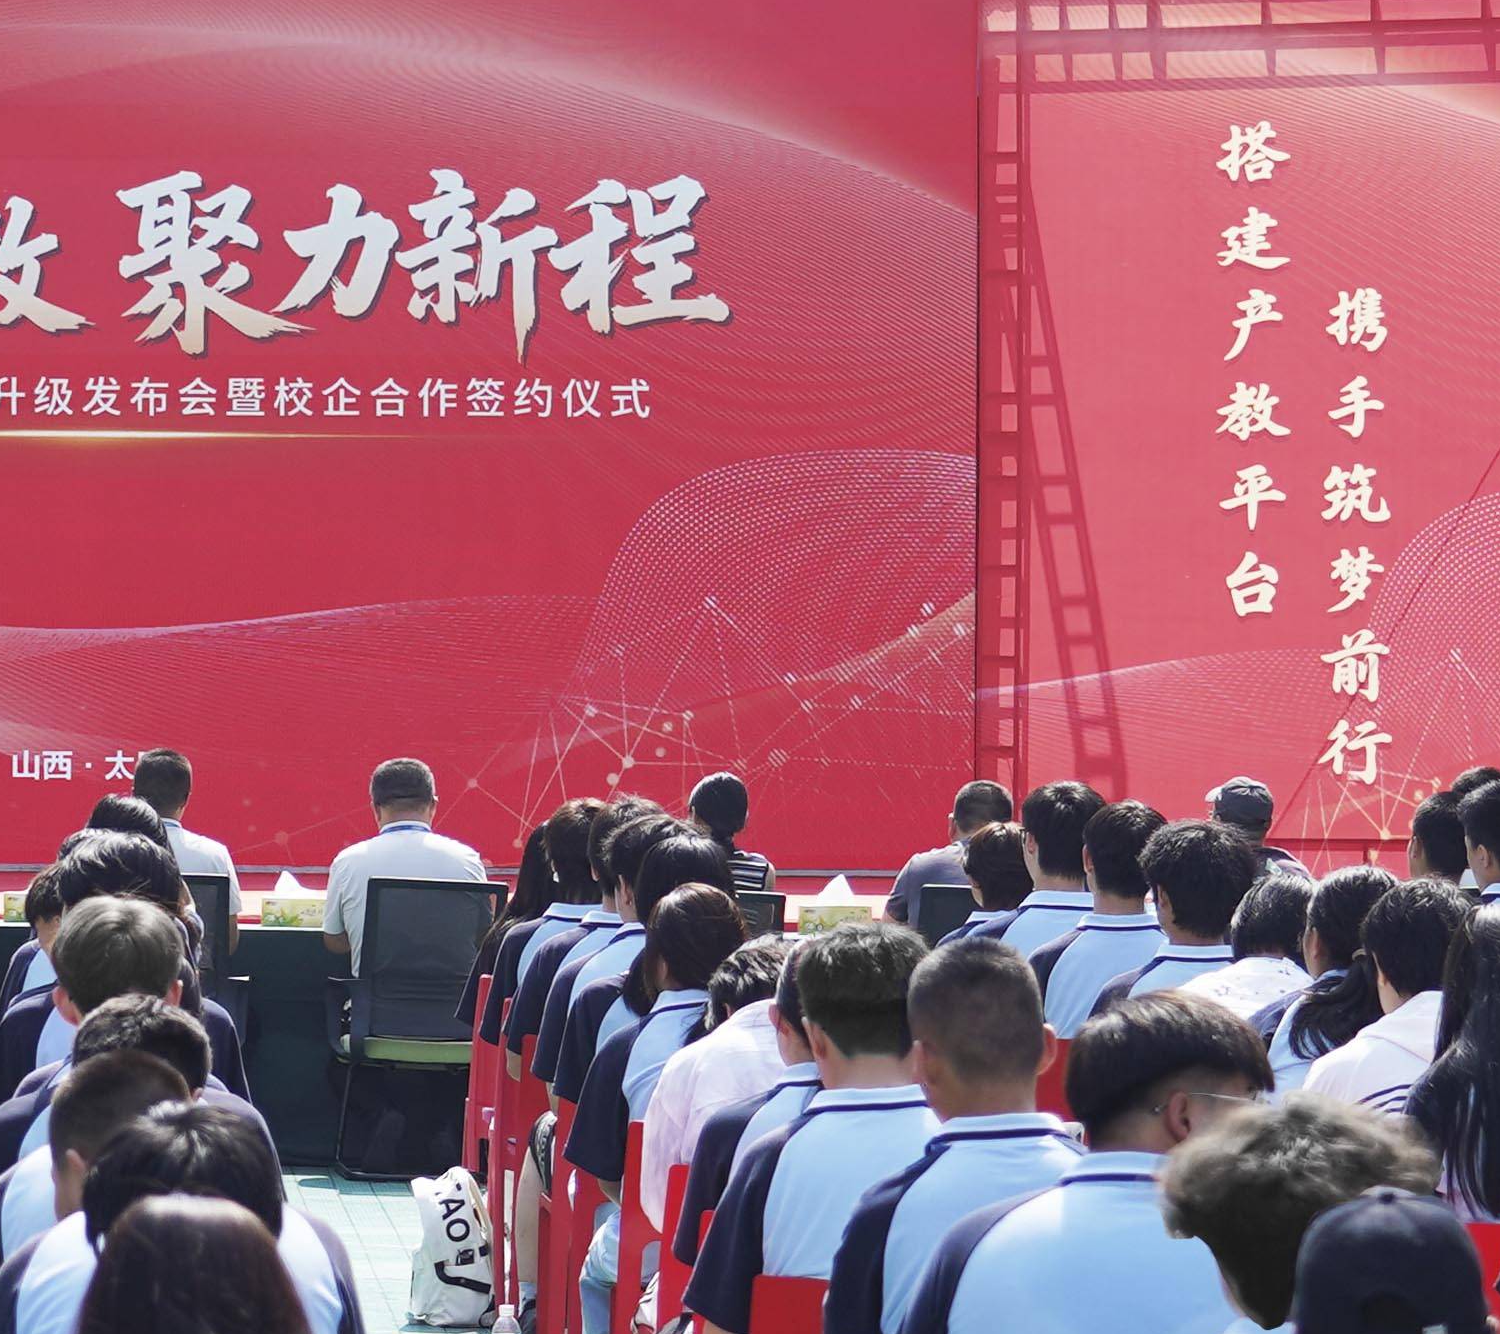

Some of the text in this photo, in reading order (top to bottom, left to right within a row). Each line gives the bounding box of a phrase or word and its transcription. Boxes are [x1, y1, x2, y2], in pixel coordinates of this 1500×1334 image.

[114, 167, 731, 363] 聚力新程
[1215, 119, 1292, 619] 搭建产教平台
[1317, 285, 1394, 786] 携手筑梦前行
[11, 749, 147, 780] 山西·太
